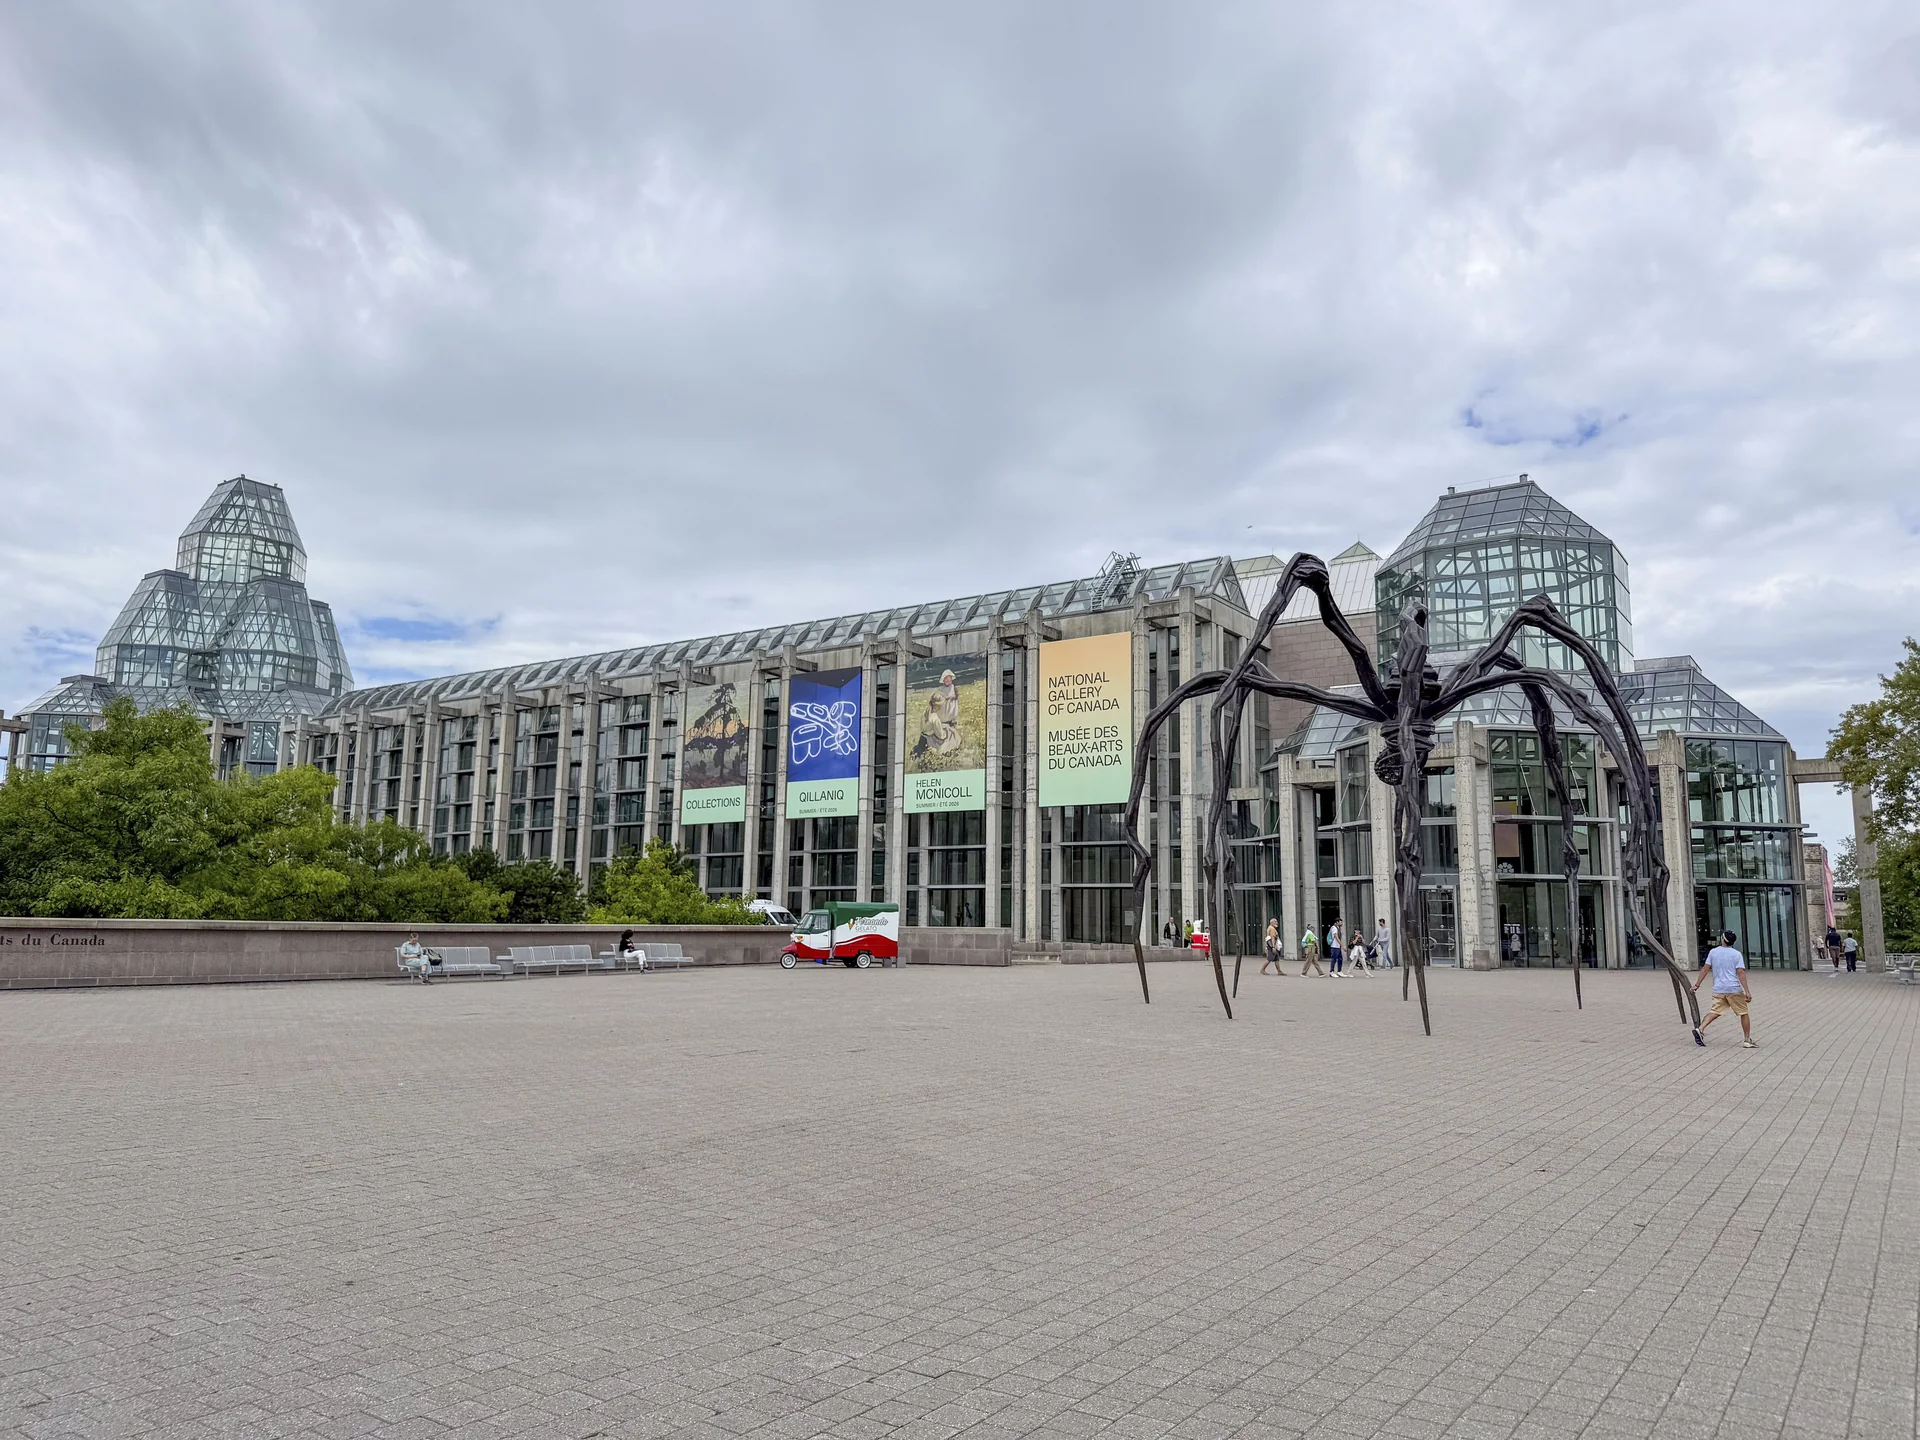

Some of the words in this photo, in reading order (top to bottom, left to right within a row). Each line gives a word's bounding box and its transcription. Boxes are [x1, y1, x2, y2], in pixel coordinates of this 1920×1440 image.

[1048, 671, 1110, 688] NATIONAL
[1048, 686, 1102, 702] GALLERY
[1048, 703, 1064, 715] OF
[1066, 698, 1120, 714] CANADA
[1048, 726, 1091, 742] MUSÉE
[1094, 725, 1119, 739] DES
[1048, 739, 1123, 756] BEAUX-ARTS
[1048, 758, 1066, 770] DU
[1068, 754, 1122, 769] CANADA
[916, 779, 941, 787] HELEN
[799, 790, 844, 802] QILLANIQ
[916, 786, 972, 800] MCNICOLL
[686, 797, 741, 809] COLLECTIONS
[21, 933, 41, 946] du
[50, 933, 105, 946] Canada
